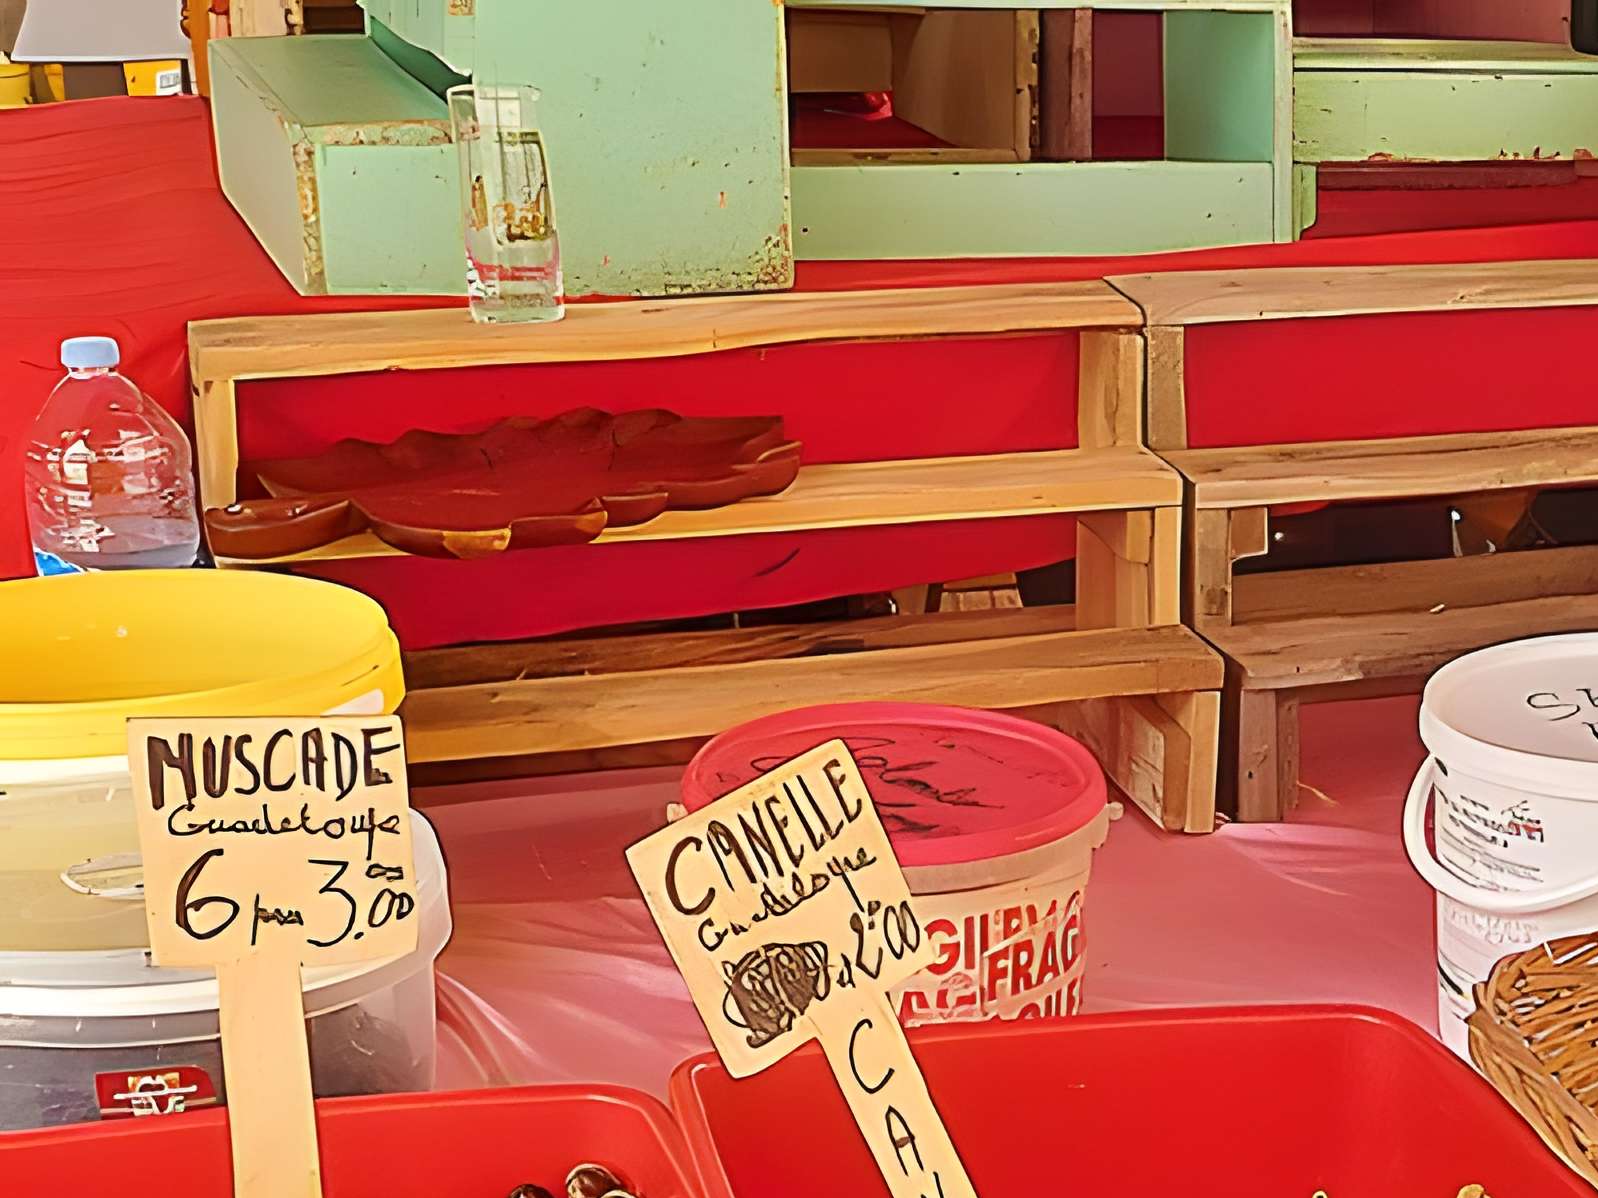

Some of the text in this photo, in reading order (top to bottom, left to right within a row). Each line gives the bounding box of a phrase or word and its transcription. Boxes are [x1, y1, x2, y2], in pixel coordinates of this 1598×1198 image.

[147, 725, 401, 811] MUSCADE
[665, 759, 862, 916] CANELLE
[175, 848, 241, 940] 6
